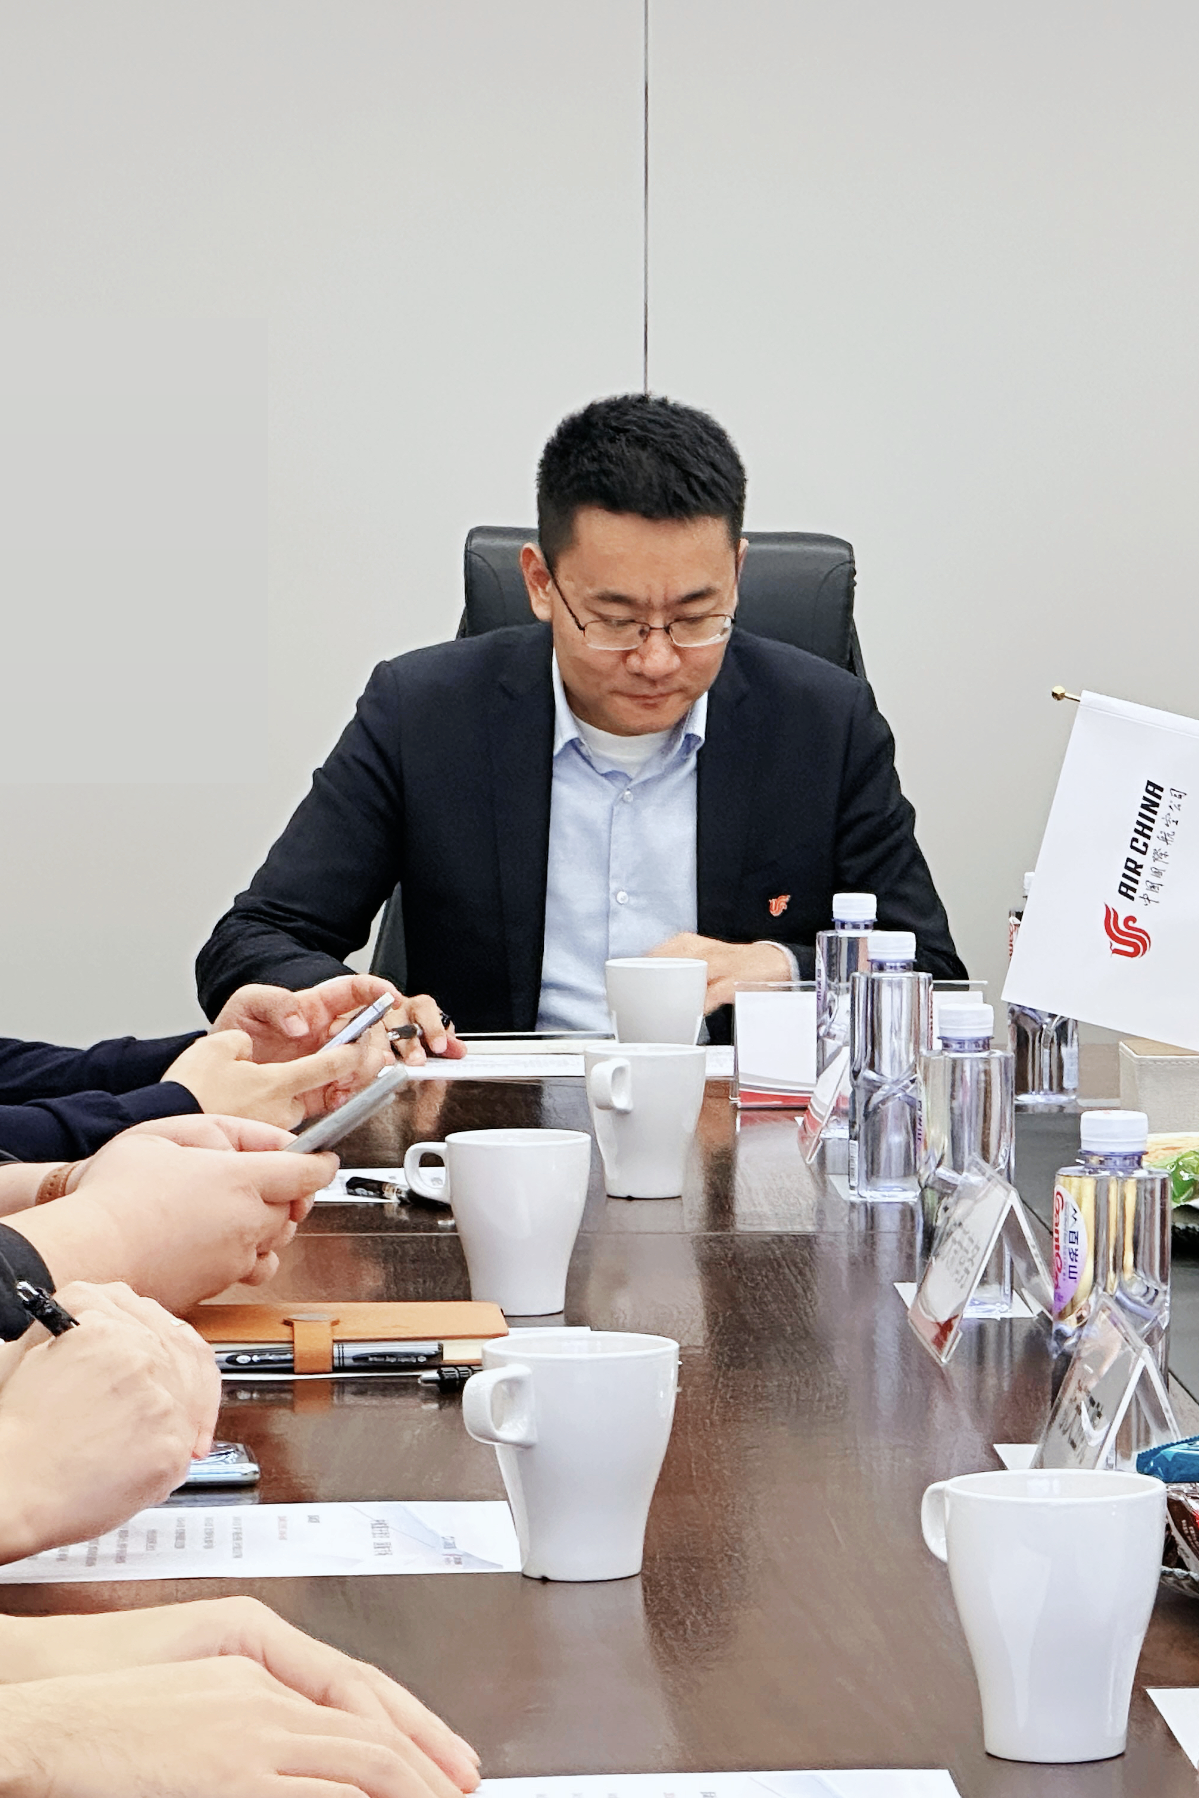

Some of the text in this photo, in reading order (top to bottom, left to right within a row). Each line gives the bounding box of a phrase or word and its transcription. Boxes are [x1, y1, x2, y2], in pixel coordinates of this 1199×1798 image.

[1118, 780, 1164, 901] AIR CHINA
[1068, 1230, 1079, 1280] 百岁山
